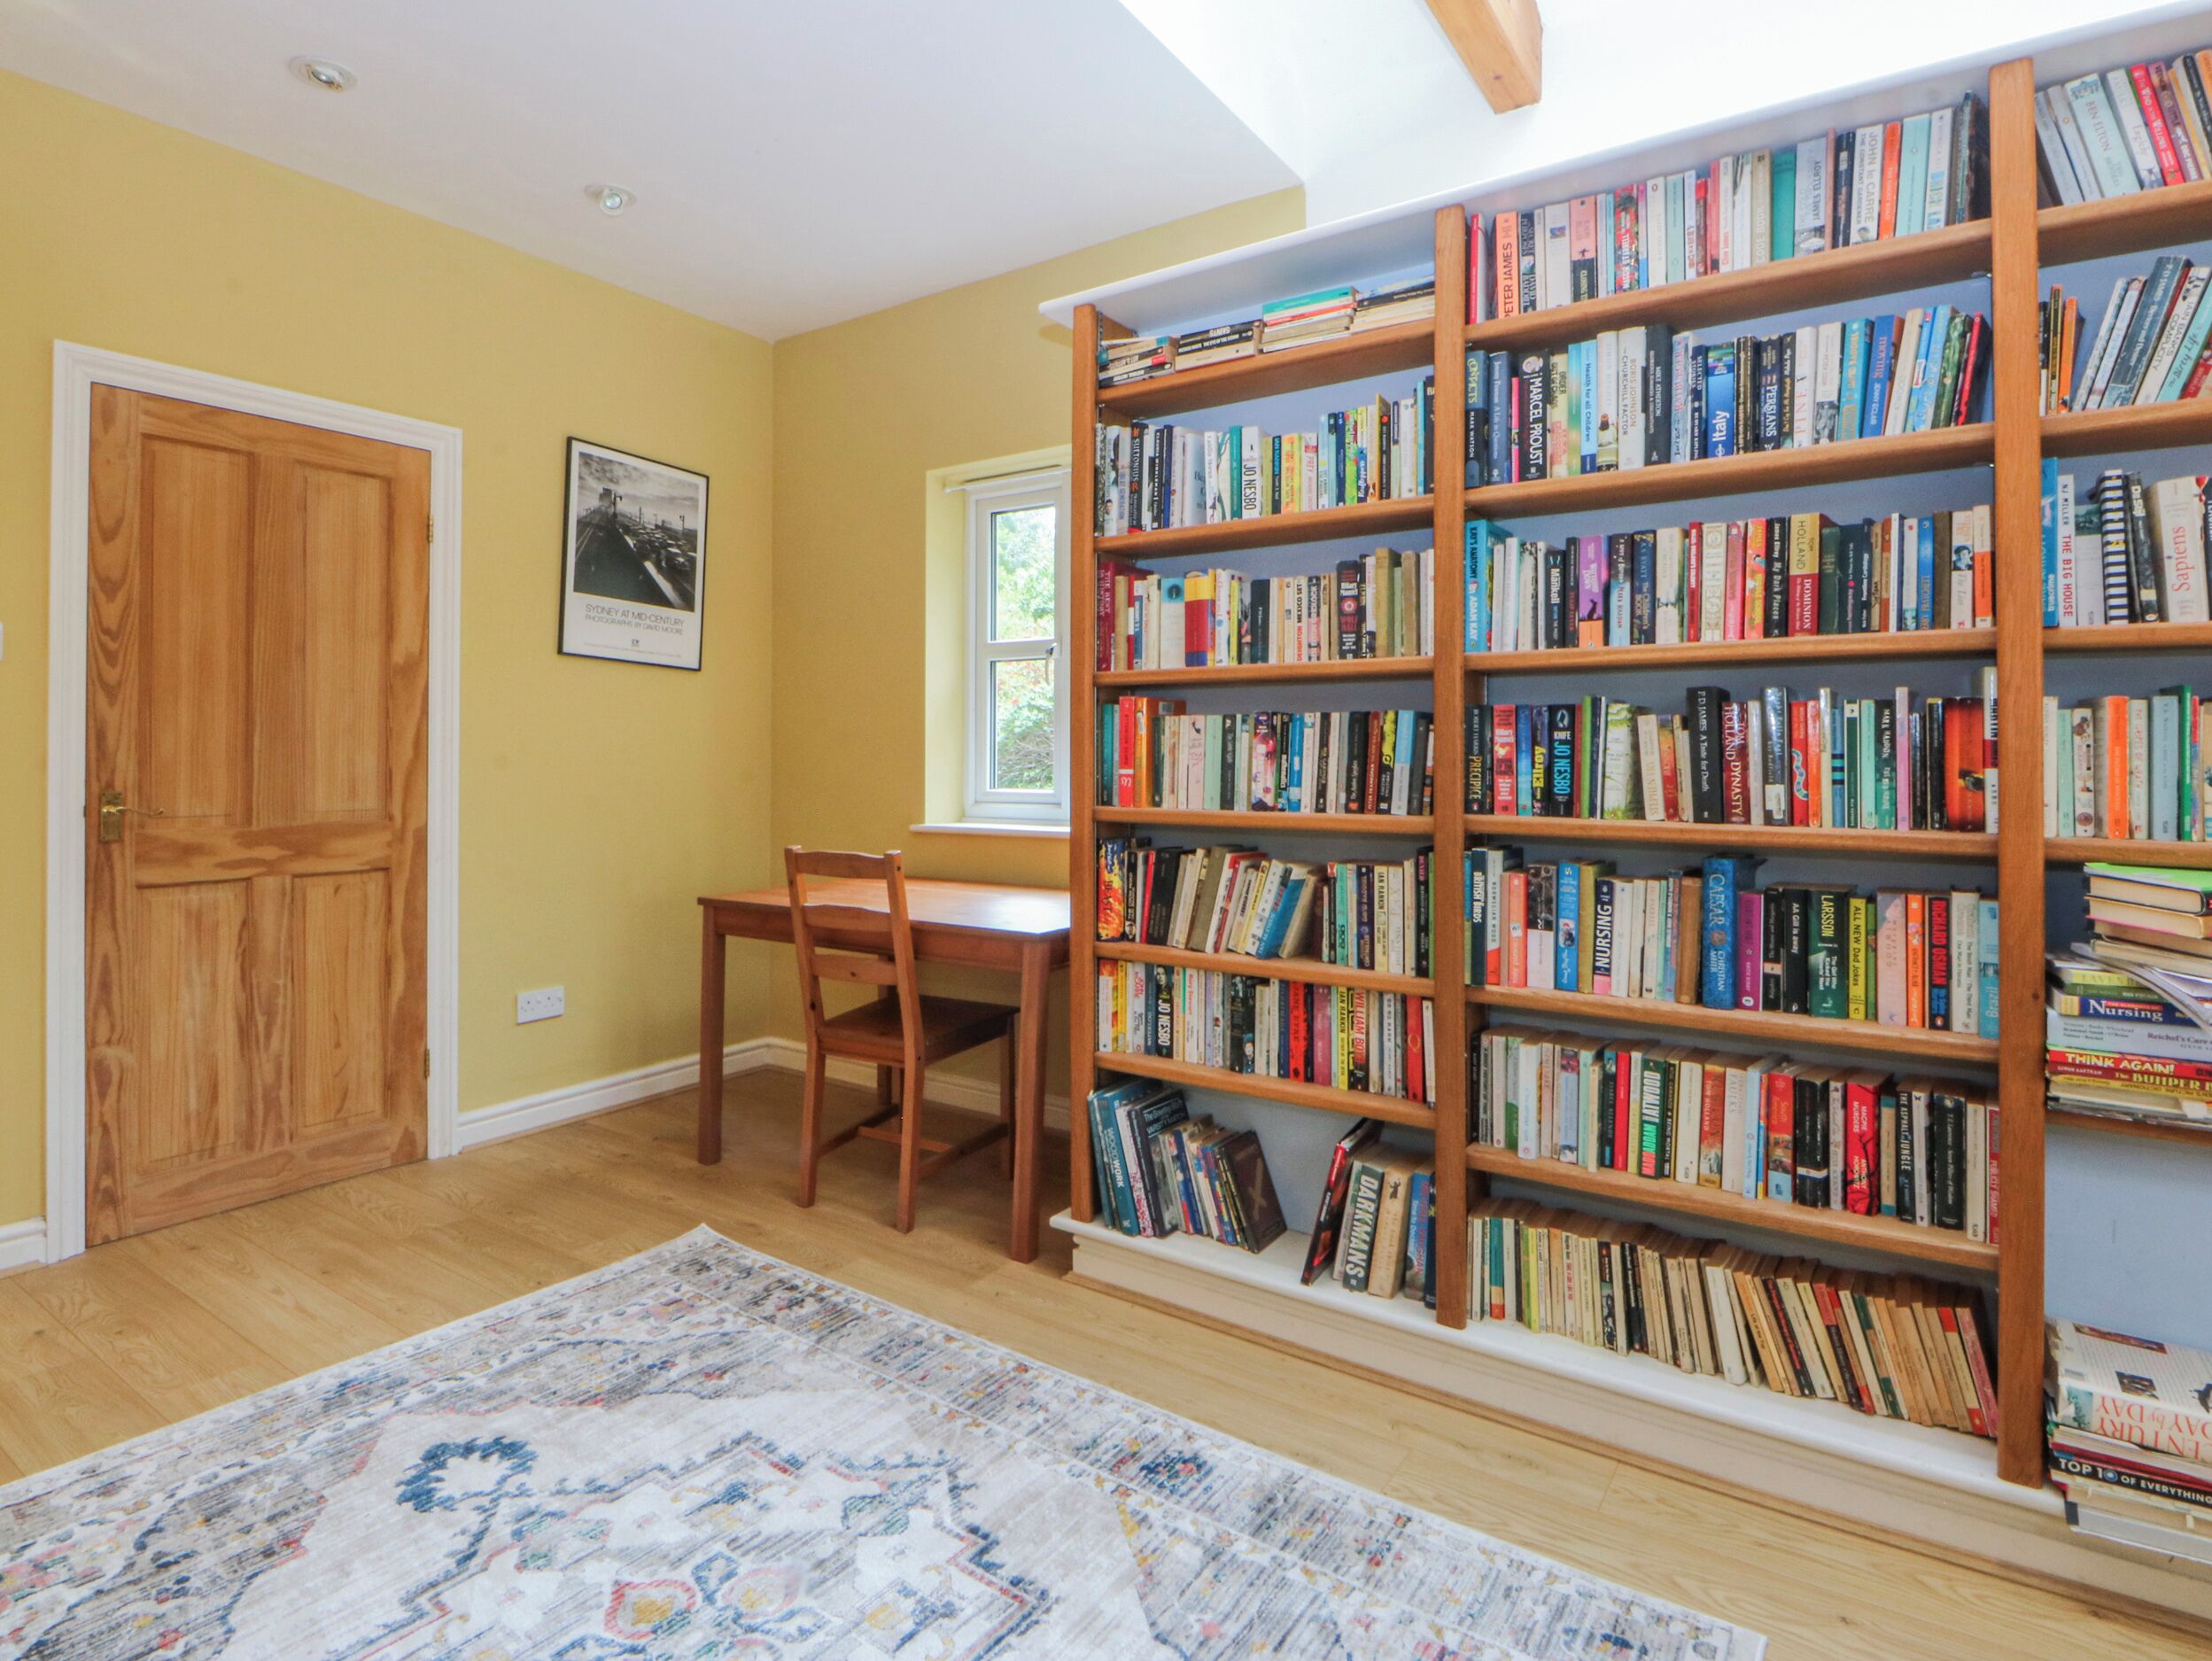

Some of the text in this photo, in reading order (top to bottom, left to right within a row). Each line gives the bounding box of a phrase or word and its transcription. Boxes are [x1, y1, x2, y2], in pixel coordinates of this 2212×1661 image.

[2085, 101, 2111, 152] BEN ELTON
[1868, 132, 1878, 166] JOHN
[1812, 161, 1821, 221] JAMES ELLROY
[1503, 243, 1513, 281] JAMES
[2152, 313, 2181, 370] COMPLICITY
[2166, 301, 2194, 357] IAIN BANKS
[1870, 337, 1888, 425] moving JENNY ECLAIR
[1529, 378, 1542, 465] MARCEL PROUST
[1711, 410, 1730, 441] Italy
[1764, 385, 1778, 437] PERSIANS
[1131, 438, 1141, 483] SUETONIUS
[1242, 463, 1257, 511] JO NESBO
[1797, 520, 1806, 570] HOLLAND
[2171, 525, 2198, 593] Sapiens
[1550, 568, 1560, 604] Mankell
[1772, 562, 1782, 572] My
[2062, 534, 2074, 617] THE BIG HOUSE
[1469, 596, 1478, 619] ADAM
[1804, 578, 1812, 630] DOMINION
[2047, 573, 2056, 613] truecrime
[585, 615, 633, 628] PHOTOGRAPHS
[643, 623, 661, 633] DAVID
[586, 604, 685, 628] SYDNEY AT MID-CENTURY
[1469, 619, 1478, 640] KAY
[1553, 731, 1572, 741] KNIFE
[1697, 706, 1707, 731] JAMES
[1724, 706, 1735, 760] HOLLAND
[1737, 722, 1746, 744] TOM
[1533, 746, 1545, 788] Ellroy
[1554, 741, 1571, 795] JO NESBO
[1701, 772, 1710, 792] Death
[1730, 761, 1742, 816] DYNASTY
[1472, 872, 1483, 923] BRITISH BIRDS
[1792, 903, 1800, 913] AA
[1820, 895, 1836, 937] LARSSON
[1853, 905, 1862, 923] ALL
[1595, 904, 1612, 967] NURSING
[1709, 873, 1726, 991] CAESAR CHRISTIAN
[1853, 923, 1862, 944] NEW
[1931, 900, 1947, 945] RICHARD
[1790, 935, 1799, 955] away
[1851, 964, 1861, 987] Jokes
[1931, 947, 1947, 986] OSMAN
[1157, 999, 1171, 1045] JO NESBO
[1354, 991, 1365, 1063] WILLIAM BOYD
[2088, 999, 2163, 1022] Nursing
[2146, 1031, 2185, 1045] Reichel's
[2186, 1036, 2208, 1045] Care
[2066, 1052, 2115, 1068] THINK
[2119, 1059, 2176, 1075] AGAIN!
[2132, 1073, 2201, 1091] BUMPER
[1642, 1070, 1661, 1116] ATWOOD
[1728, 1075, 1737, 1114] FAULKS
[1771, 1096, 1780, 1125] America
[1900, 1106, 1909, 1136] ASPHALT
[1106, 1128, 1125, 1188] WOODWORK
[1900, 1139, 1911, 1171] JUNGLE
[1345, 1174, 1379, 1278] DARKMANS
[2097, 1395, 2145, 1424] DAY
[2059, 1457, 2093, 1476] TOP
[2121, 1475, 2137, 1486] OF
[2140, 1481, 2212, 1505] EVERYTHING
